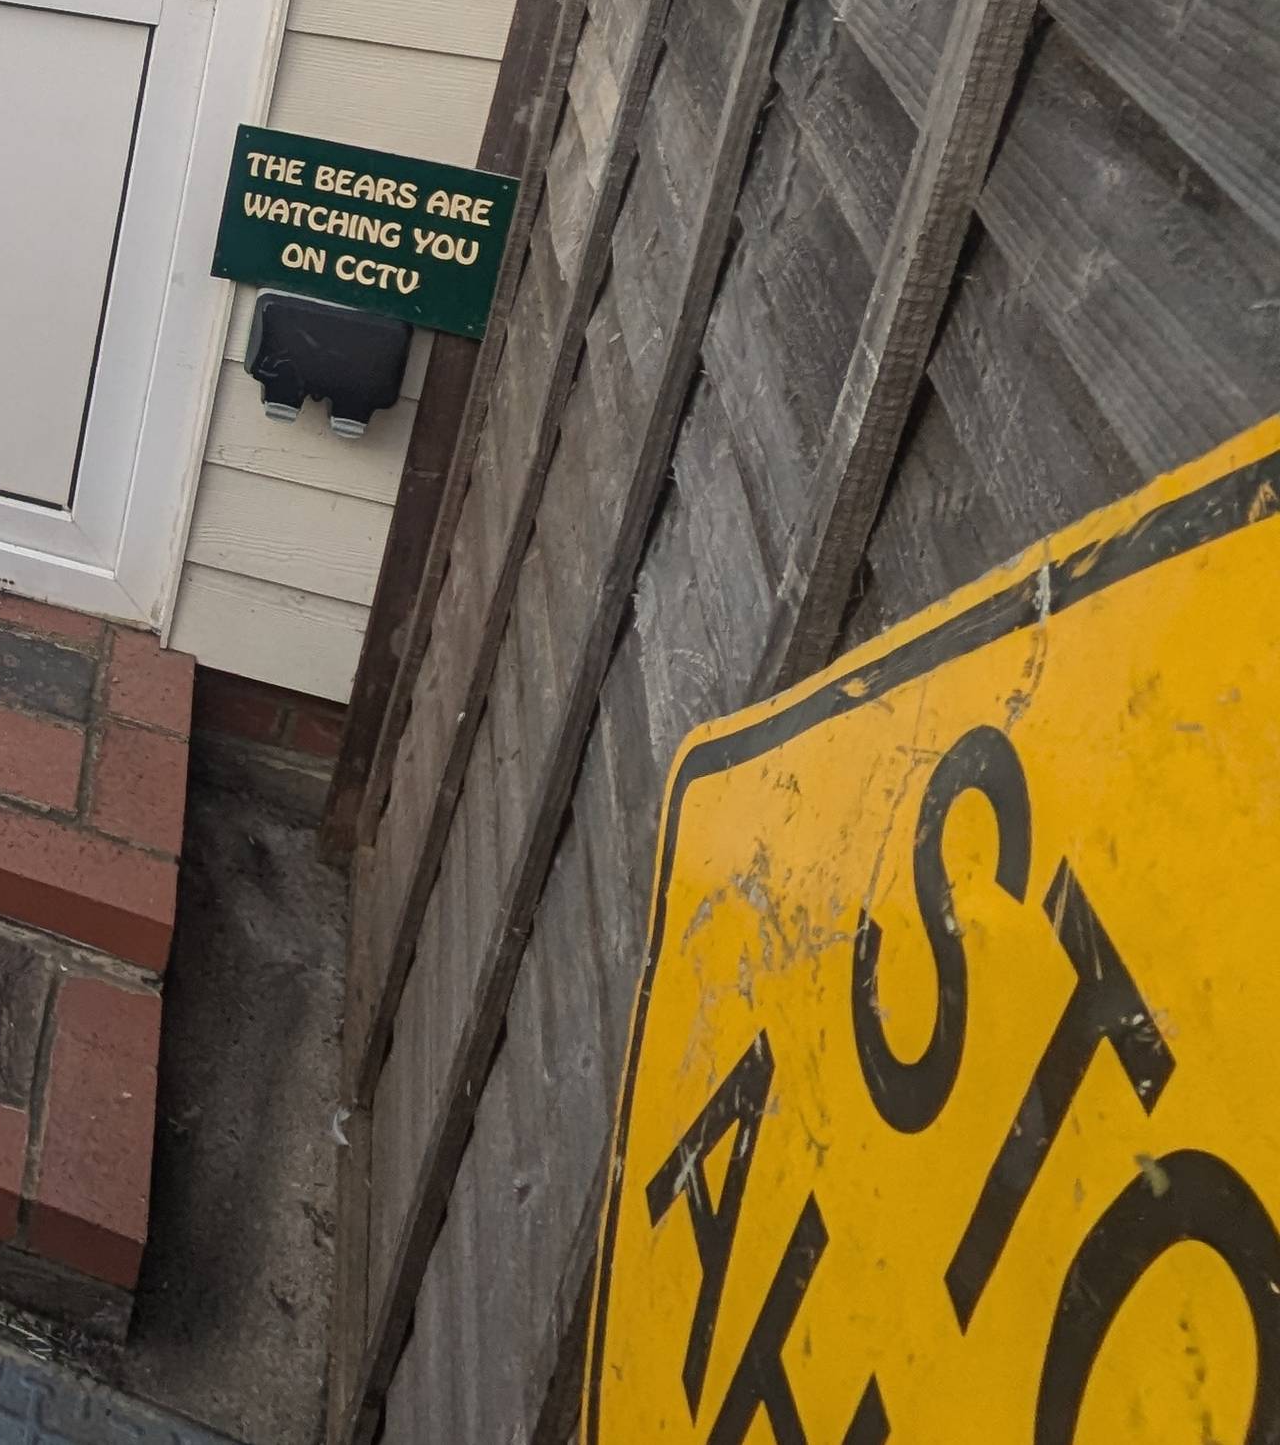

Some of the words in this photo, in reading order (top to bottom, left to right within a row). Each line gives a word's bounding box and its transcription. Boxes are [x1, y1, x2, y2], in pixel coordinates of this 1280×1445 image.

[247, 152, 306, 186] THE
[314, 165, 419, 209] BEARS
[426, 189, 494, 227] ARE
[243, 192, 403, 249] WATCHING
[413, 227, 480, 266] YOU
[281, 242, 327, 274] ON
[335, 255, 421, 295] CCTV
